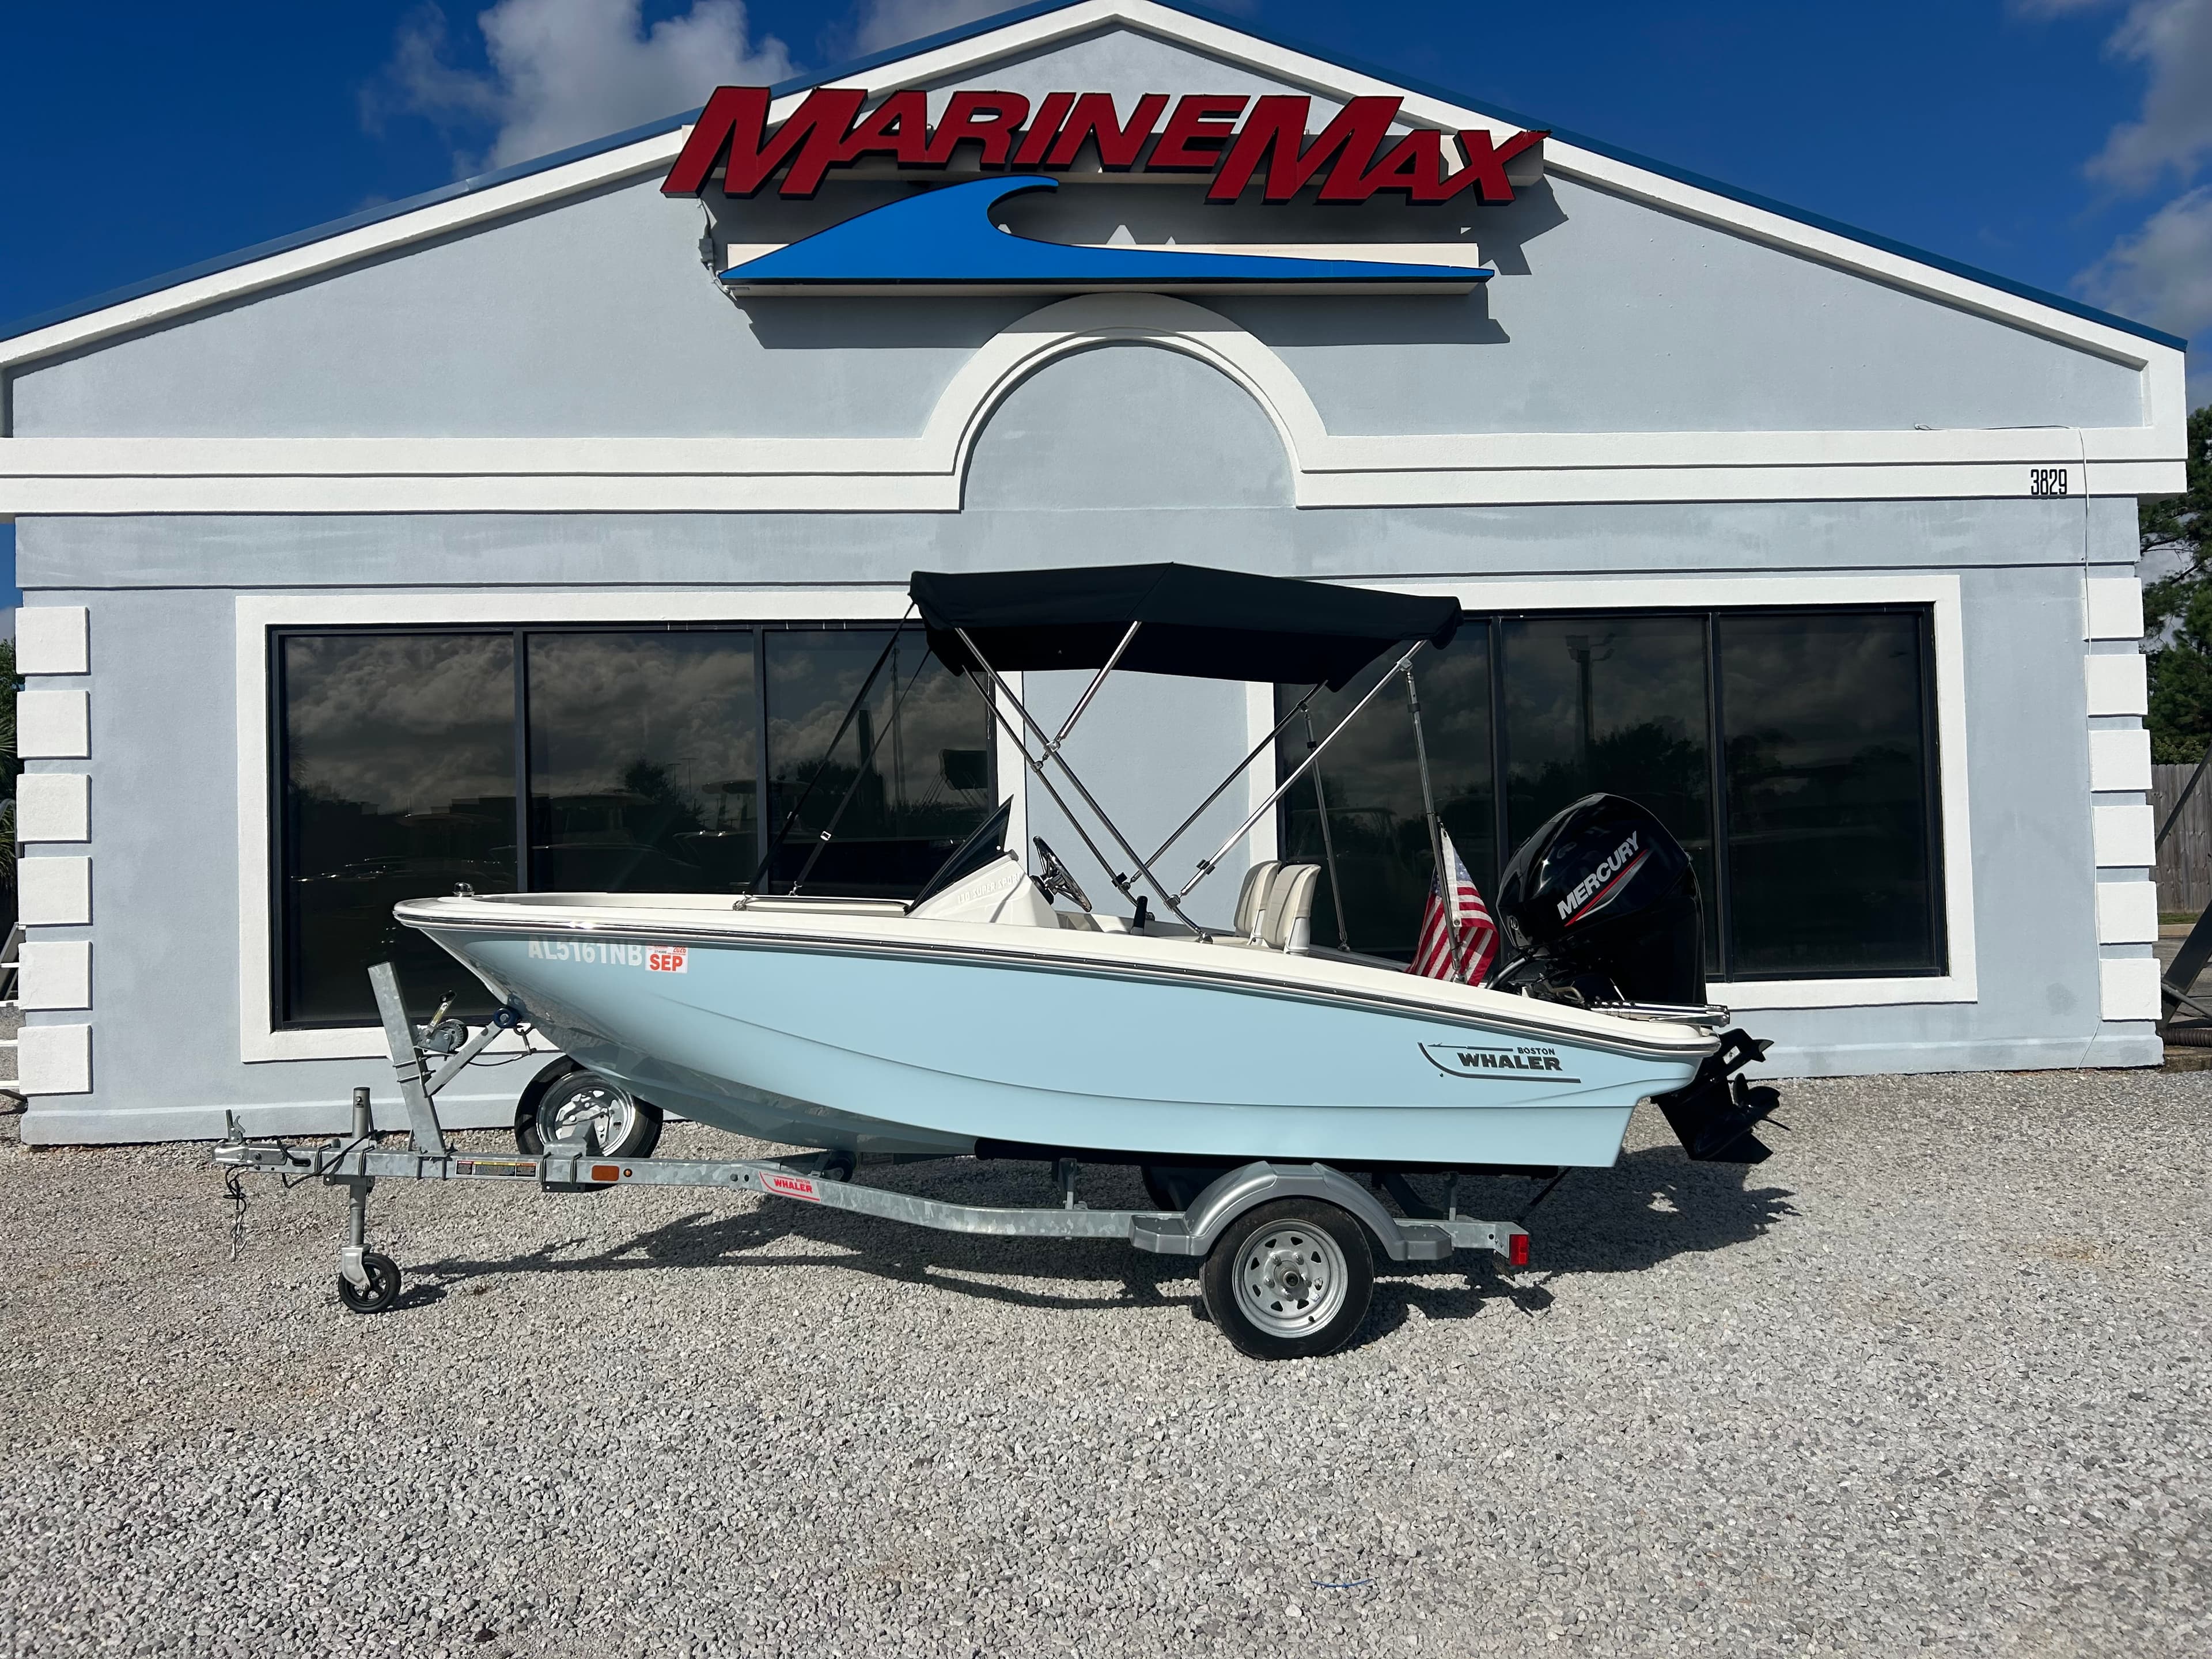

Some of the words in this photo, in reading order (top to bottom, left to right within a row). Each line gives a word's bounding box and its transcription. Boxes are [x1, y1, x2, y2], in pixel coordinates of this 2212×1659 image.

[2031, 469, 2067, 495] 3829
[1557, 831, 1639, 920] MERCURY
[973, 882, 995, 897] SUPER
[529, 934, 642, 965] AL5161NB
[650, 954, 683, 971] SEP
[1517, 1047, 1555, 1055] BOSTON
[1457, 1053, 1563, 1071] WHALER
[774, 1179, 813, 1193] WHALER
